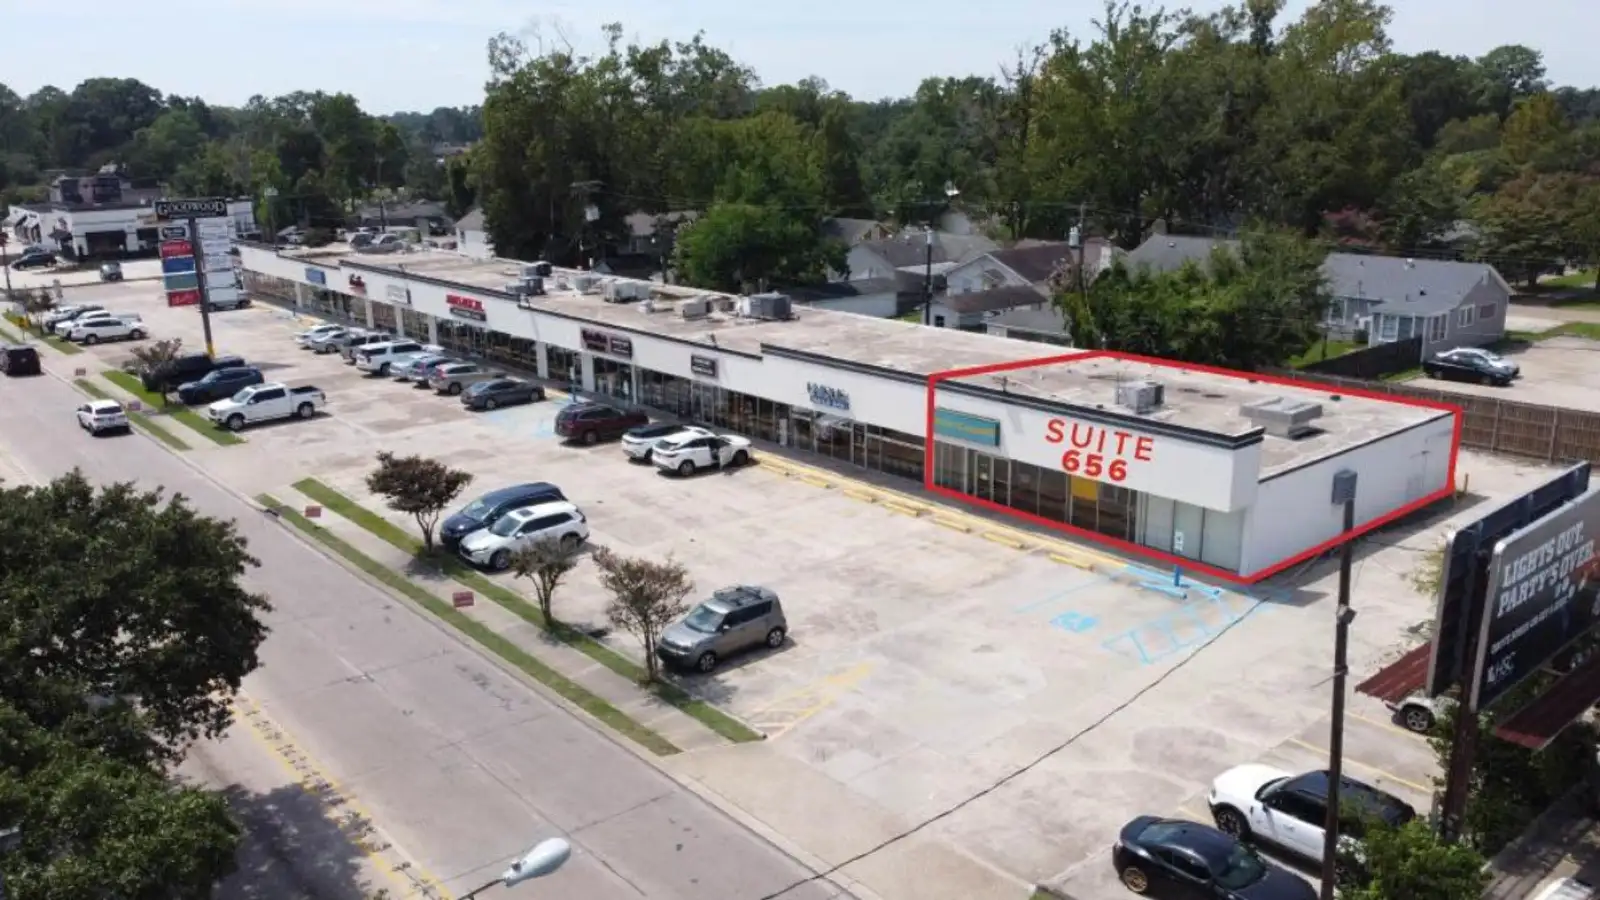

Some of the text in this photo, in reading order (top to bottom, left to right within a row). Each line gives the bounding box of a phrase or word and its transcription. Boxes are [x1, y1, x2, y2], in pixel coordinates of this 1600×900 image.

[157, 202, 225, 216] GOODWOOD
[1502, 536, 1555, 589] LIGHTS
[1497, 562, 1559, 618] PARTY'S
